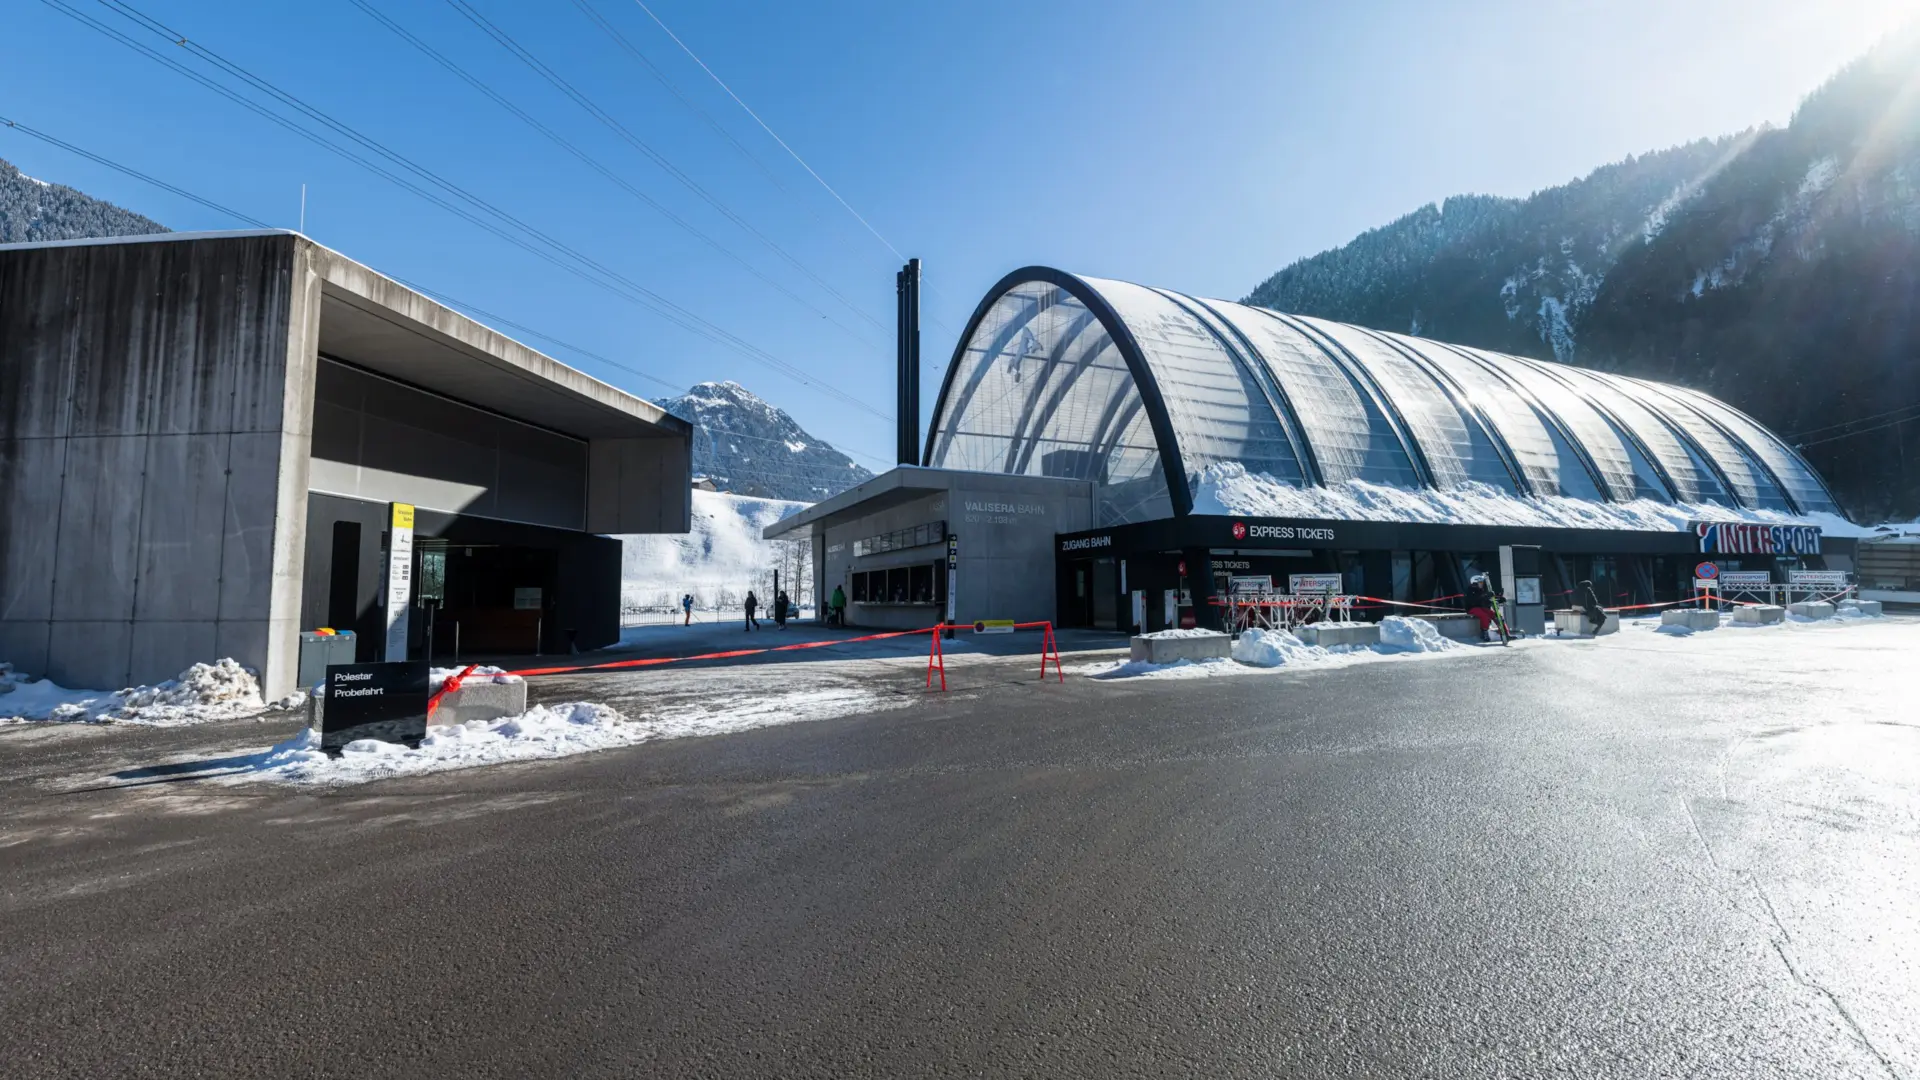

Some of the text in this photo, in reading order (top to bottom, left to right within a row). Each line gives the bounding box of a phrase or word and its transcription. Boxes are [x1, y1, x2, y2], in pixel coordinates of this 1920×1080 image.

[964, 501, 1045, 515] VALISERA BAHN
[1249, 525, 1335, 540] EXPRESS TICKETS
[1716, 523, 1822, 554] INTERSPORT
[1062, 535, 1112, 551] ZUGANG BAHN
[1224, 561, 1251, 570] TICKETS
[334, 672, 373, 682] Polestar
[334, 687, 384, 698] Probefahrt
